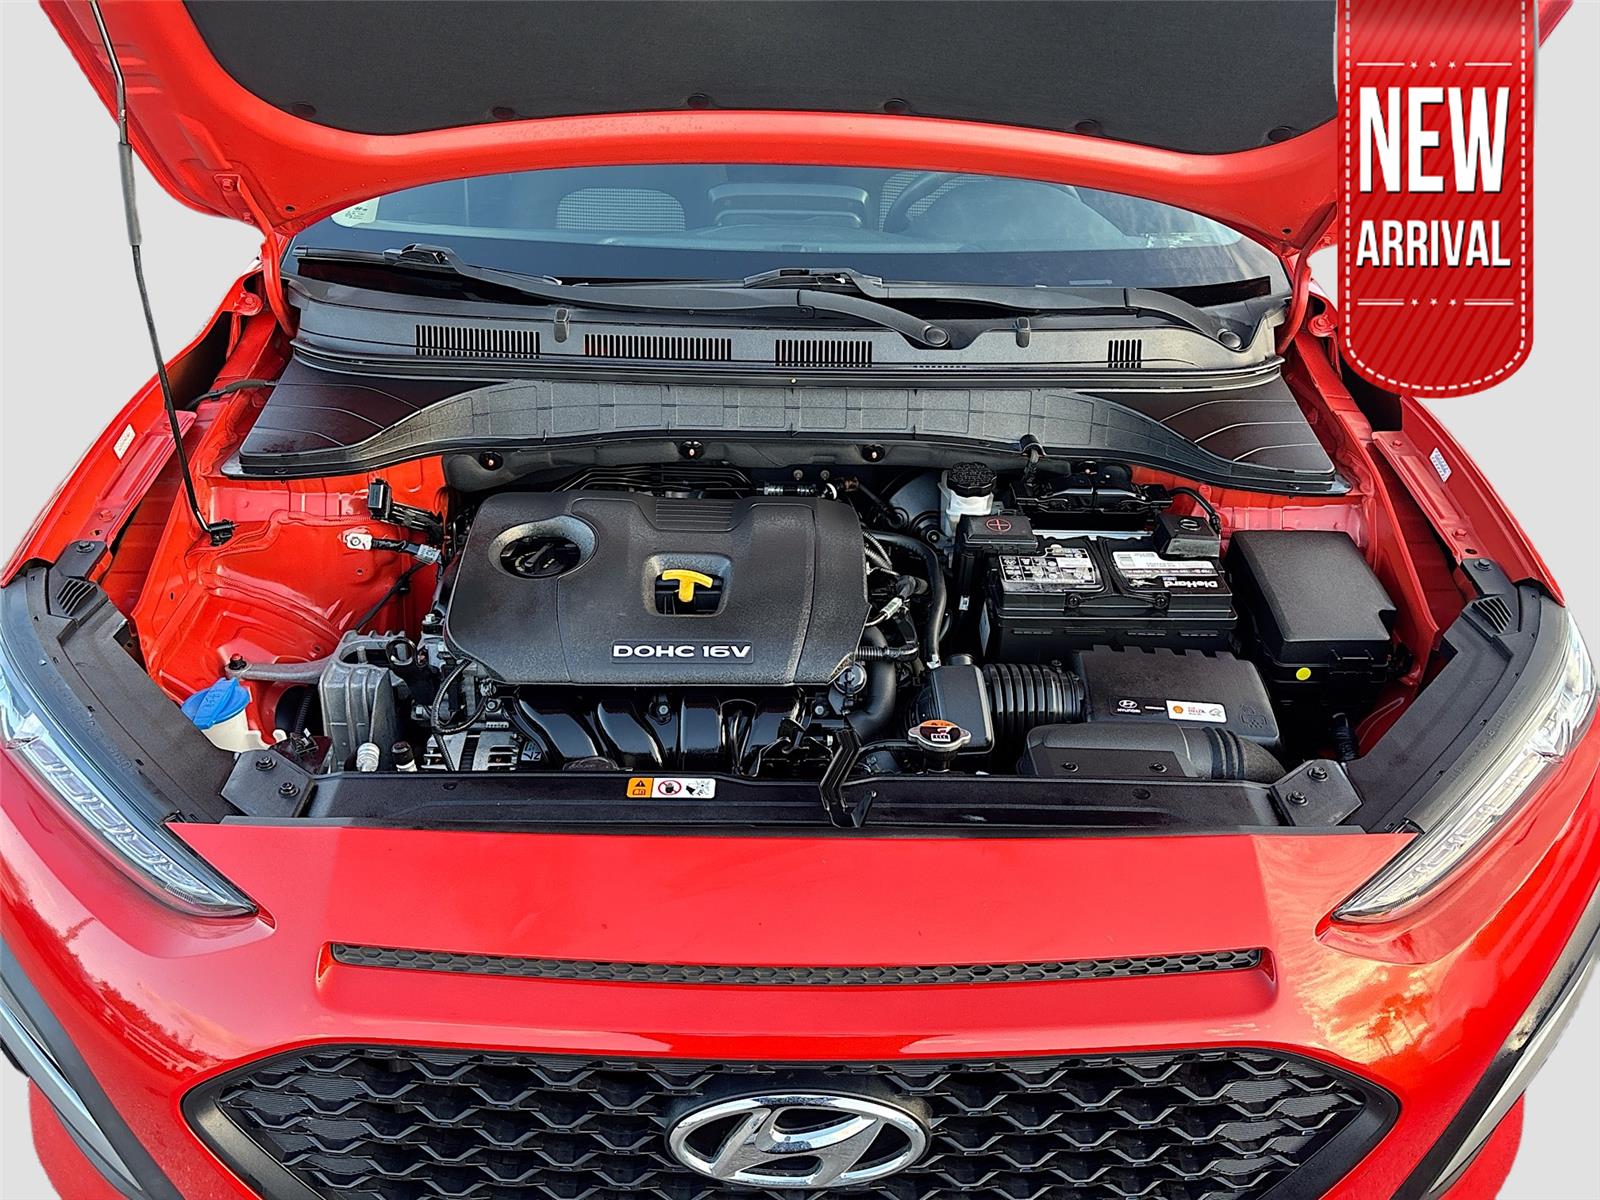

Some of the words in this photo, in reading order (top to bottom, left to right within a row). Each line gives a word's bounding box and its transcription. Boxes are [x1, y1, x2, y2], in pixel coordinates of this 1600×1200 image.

[1163, 580, 1218, 588] DieHard
[613, 645, 695, 658] DOHC
[702, 645, 751, 658] 16V
